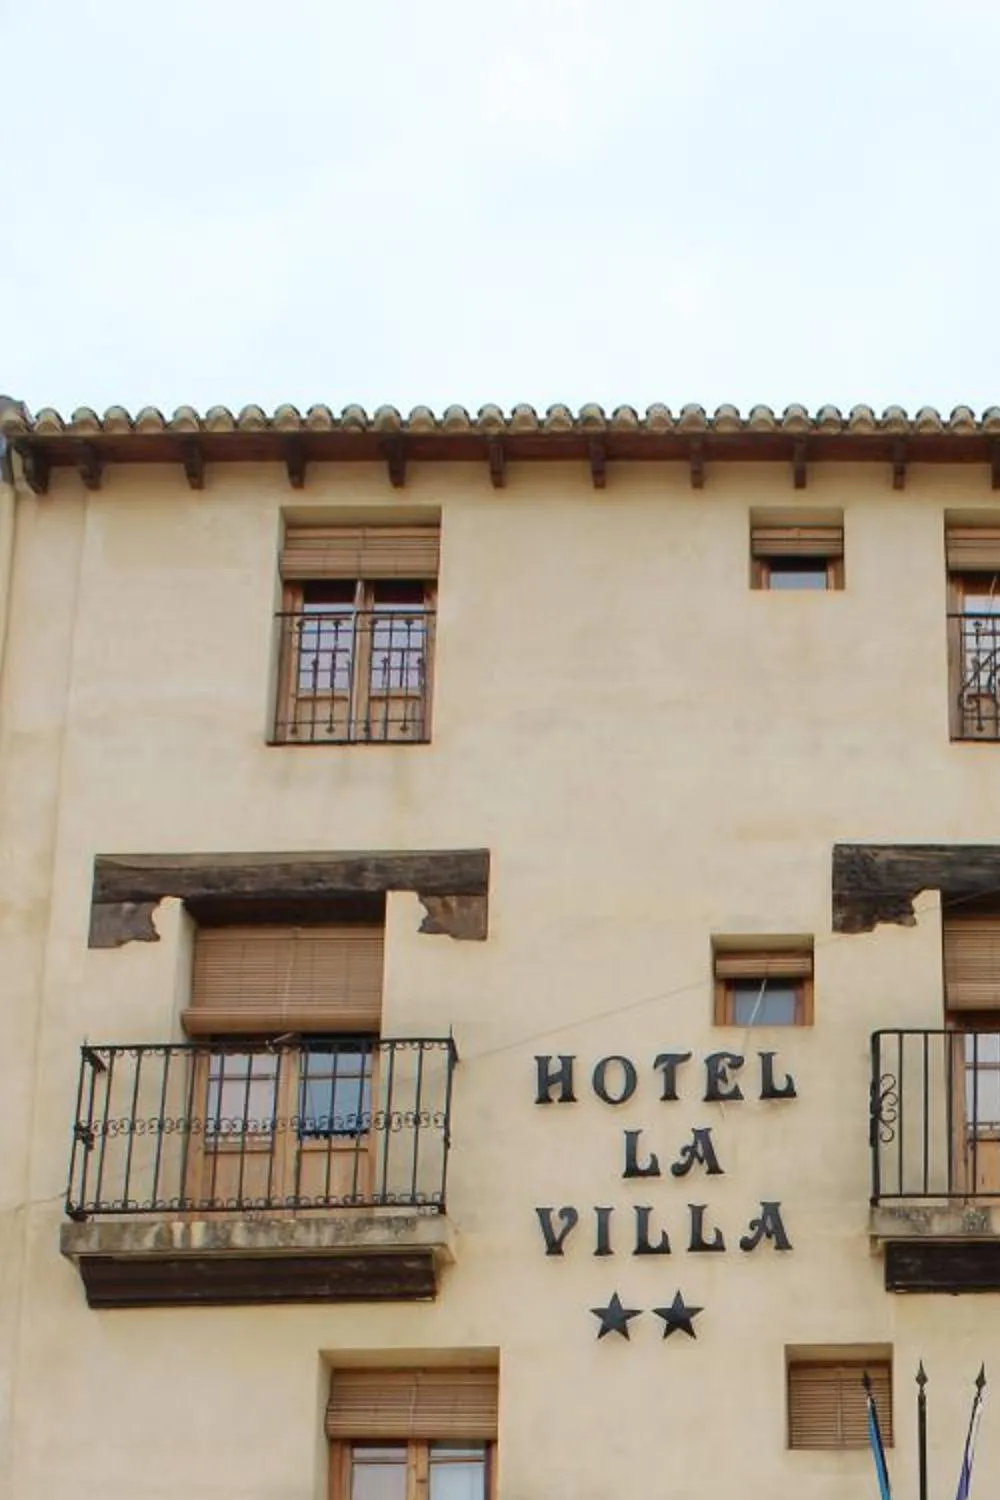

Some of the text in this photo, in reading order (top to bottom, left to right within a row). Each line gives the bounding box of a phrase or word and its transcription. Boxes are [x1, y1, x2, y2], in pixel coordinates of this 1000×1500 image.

[533, 1051, 798, 1105] HOTEL
[622, 1127, 726, 1179] LA
[535, 1201, 794, 1256] VILLA
